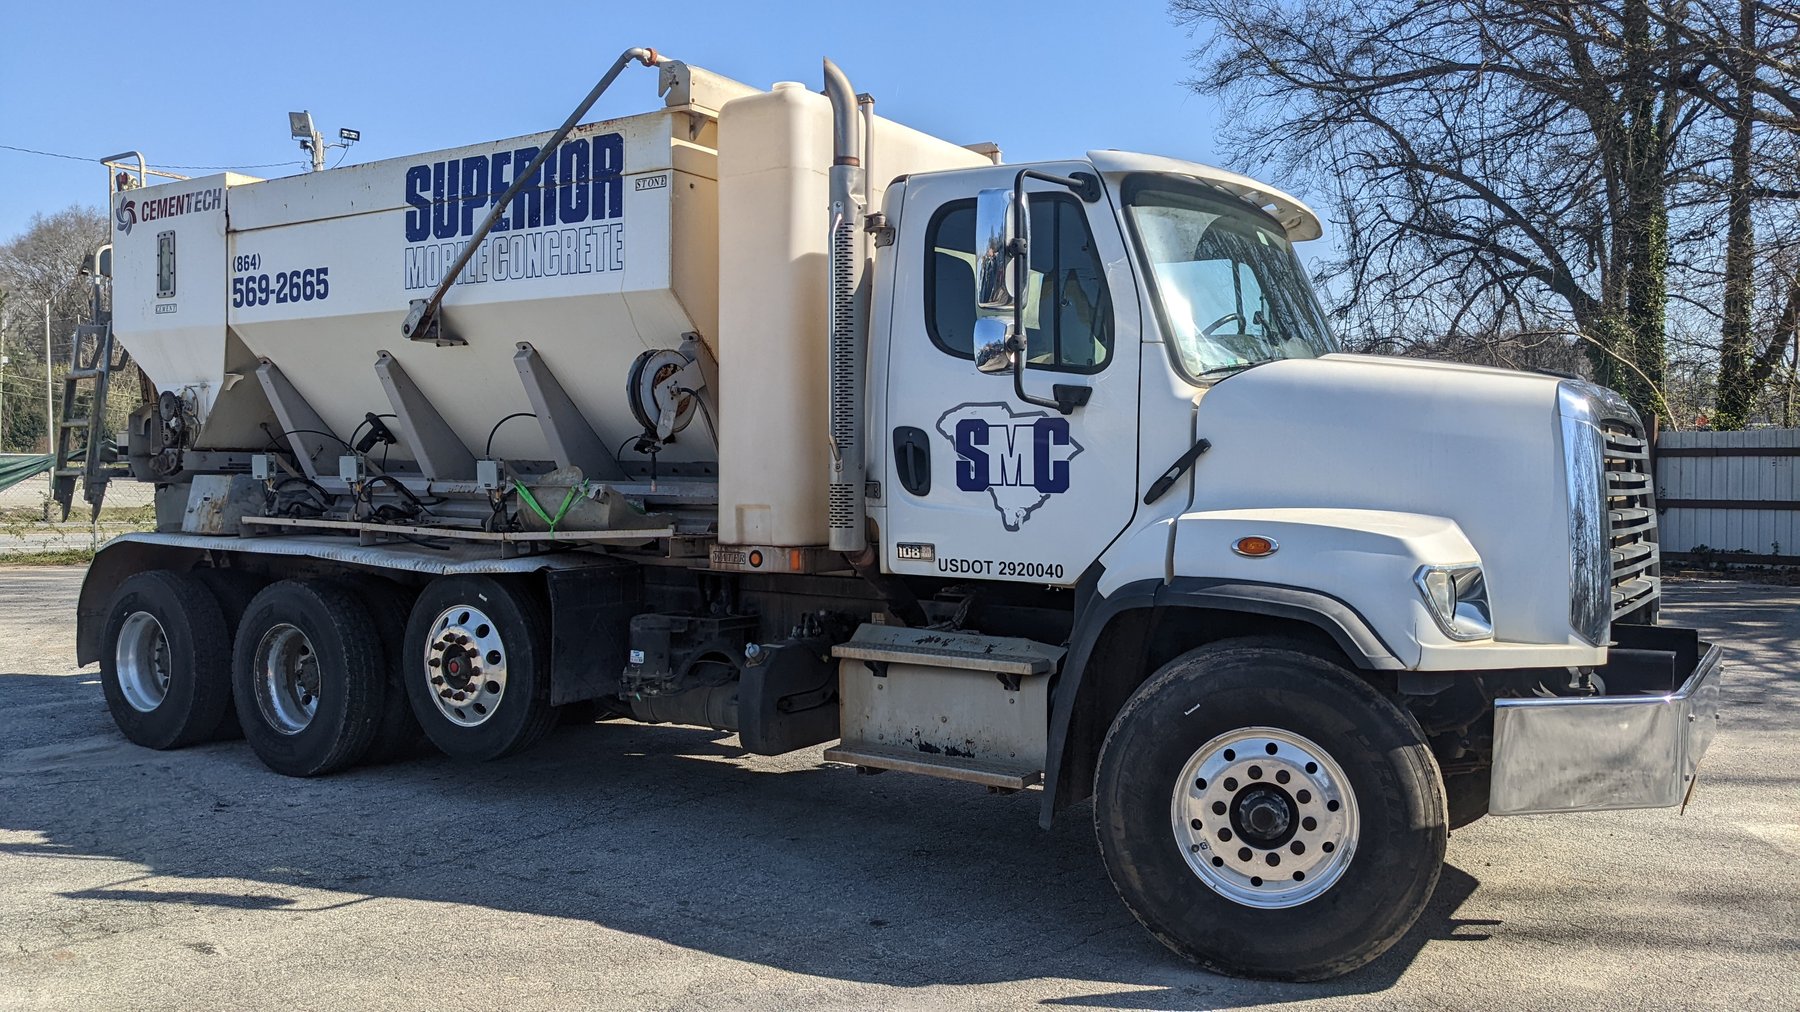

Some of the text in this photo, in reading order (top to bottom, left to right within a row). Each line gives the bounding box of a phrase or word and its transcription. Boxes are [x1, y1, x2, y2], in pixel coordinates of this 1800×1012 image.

[405, 132, 624, 243] SUPERIOR
[636, 176, 667, 190] STONE
[233, 253, 261, 273] (864)
[405, 223, 623, 289] MOBILE CONCRETE
[232, 267, 329, 308] 569-2665
[955, 417, 1070, 494] SMC
[713, 551, 746, 564] WATER
[938, 558, 1064, 579] USDOT 2920040
